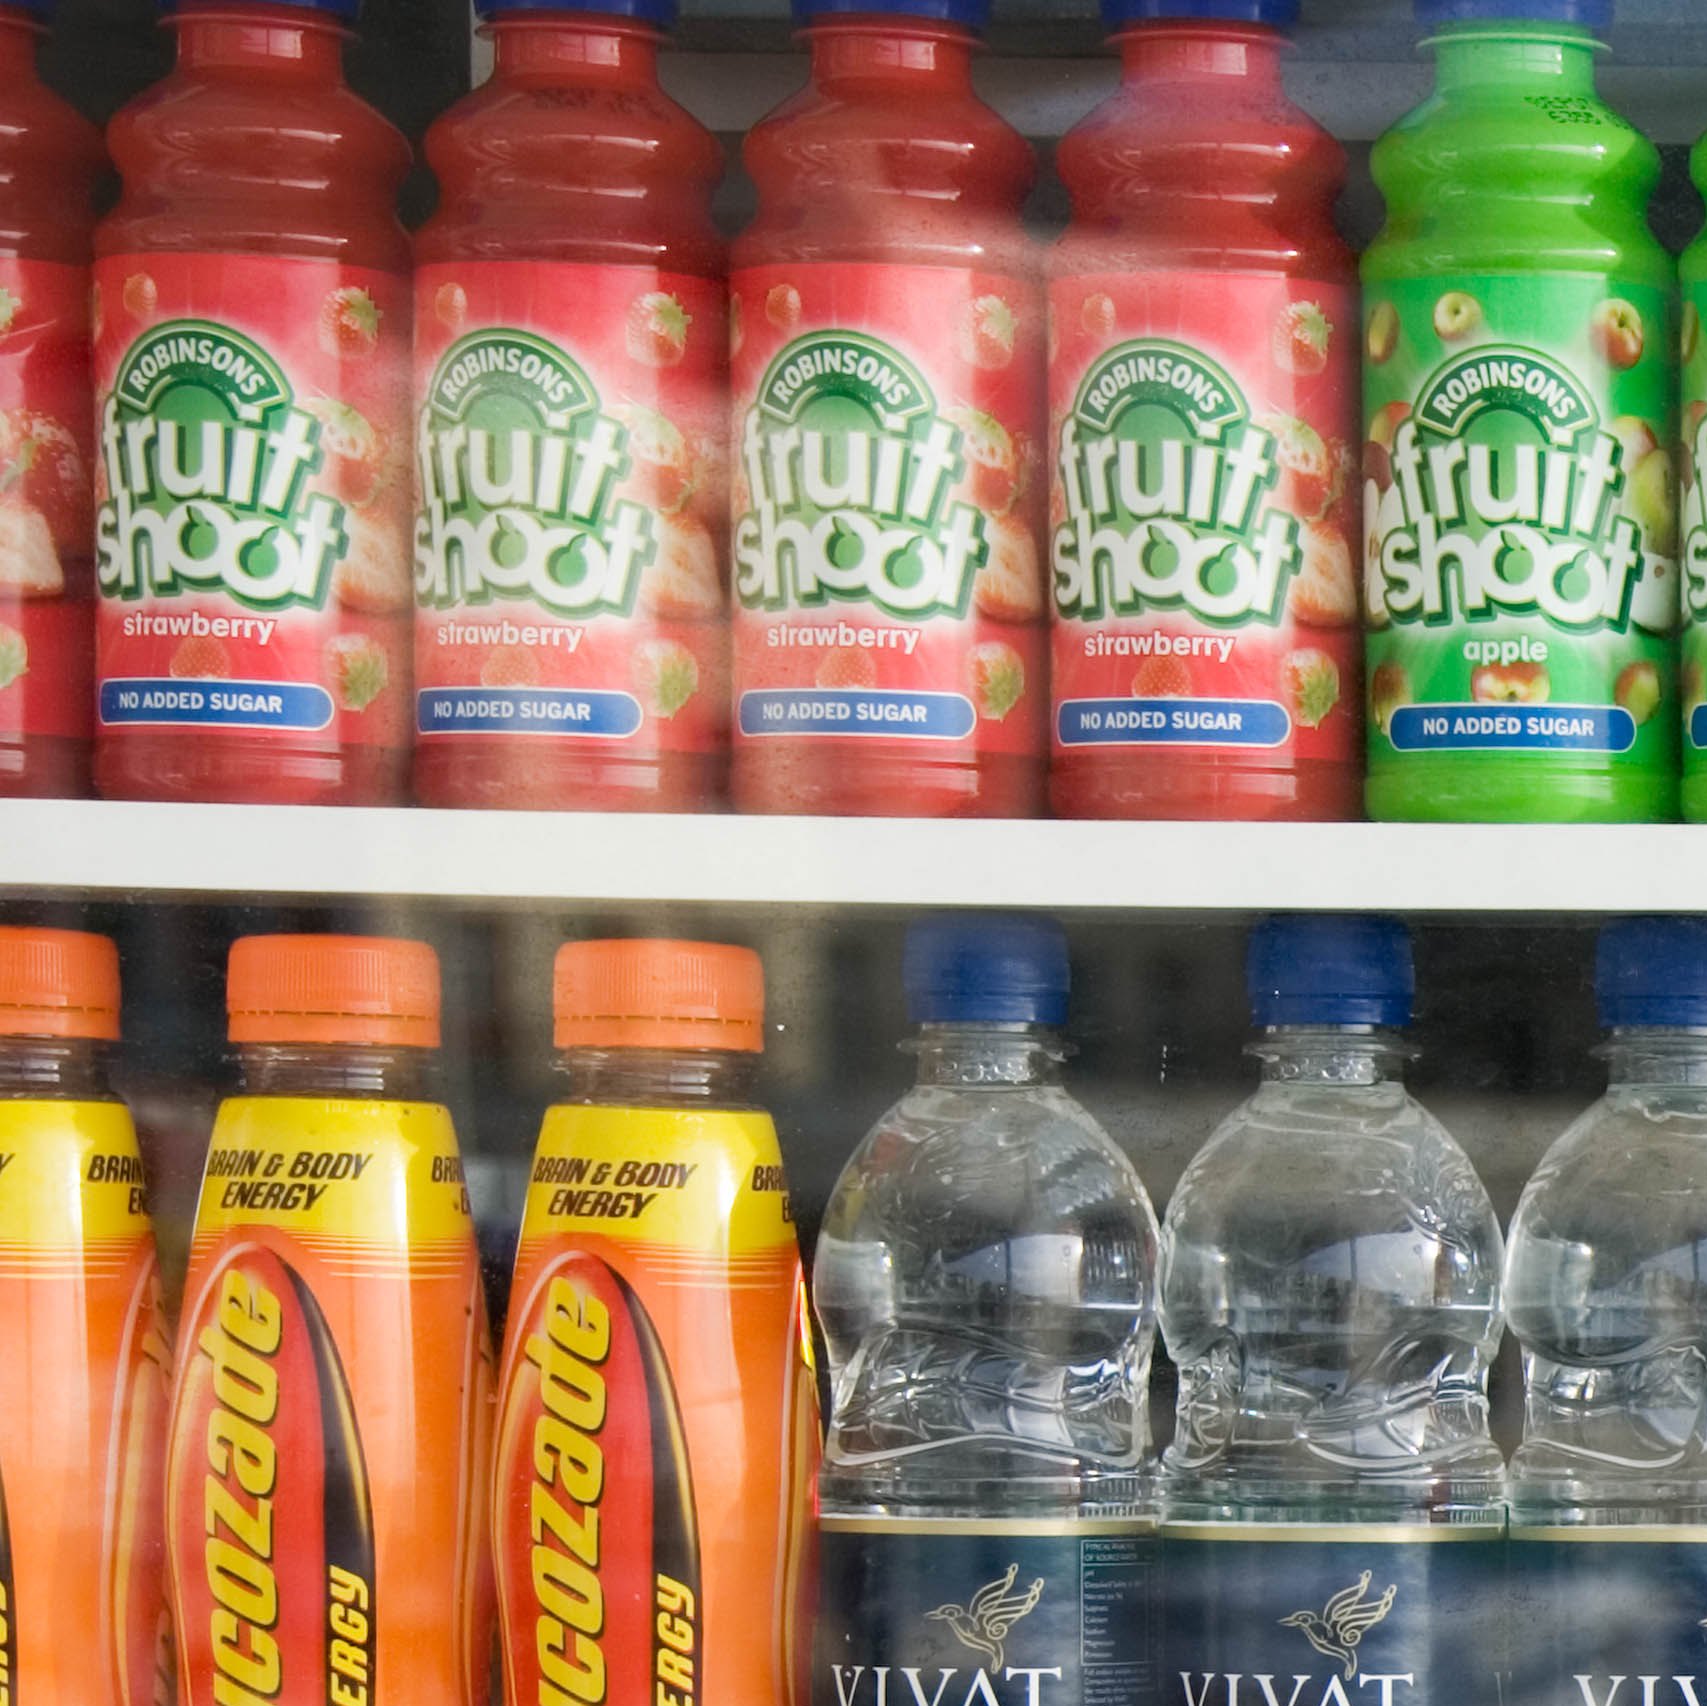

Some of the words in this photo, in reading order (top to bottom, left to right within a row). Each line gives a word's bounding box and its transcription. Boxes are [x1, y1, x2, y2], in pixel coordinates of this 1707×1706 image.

[128, 338, 268, 397] ROBINSONS
[1088, 356, 1223, 414] ROBINSONS
[1432, 362, 1576, 418] ROBINSONS
[103, 401, 312, 507] fruit
[1061, 416, 1269, 523] fruit
[1395, 424, 1616, 530] fruit
[98, 494, 338, 598] shoot
[1055, 510, 1294, 616] shoot
[1384, 515, 1636, 622] shoot
[123, 611, 275, 645] strawberry
[1085, 629, 1235, 662] strawberry
[1464, 635, 1548, 666] apple
[119, 691, 140, 709] NO
[143, 692, 204, 709] ADDED
[211, 693, 282, 713] SUGAR
[1081, 712, 1101, 729] NO
[1105, 712, 1166, 728] ADDED
[1173, 712, 1242, 730] SUGAR
[1424, 718, 1448, 734] NO
[1454, 717, 1521, 734] ADDED
[1527, 717, 1594, 736] SUGAR
[262, 1154, 284, 1177] &
[287, 1151, 373, 1180] BODY
[591, 1162, 612, 1186] &
[613, 1160, 697, 1188] BODY
[222, 1181, 327, 1210] ENERGY
[548, 1189, 656, 1218] ENERGY
